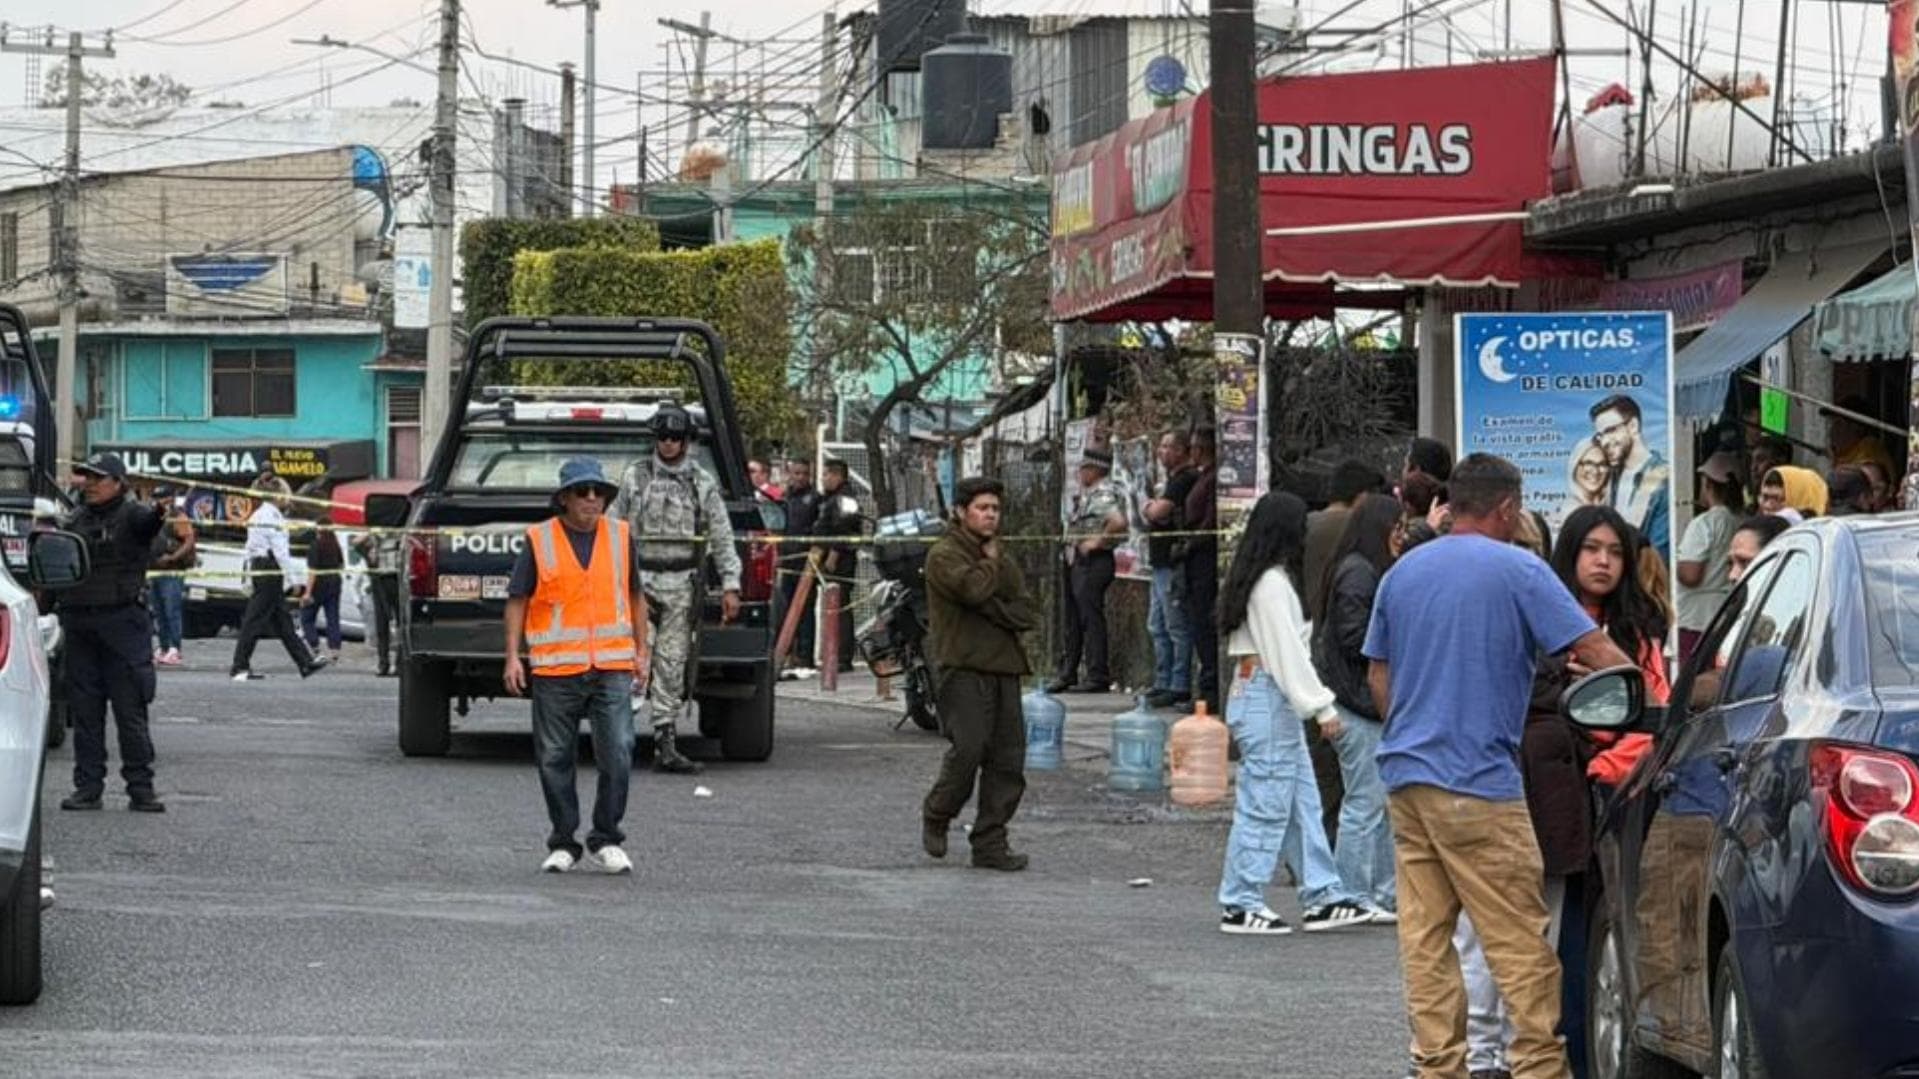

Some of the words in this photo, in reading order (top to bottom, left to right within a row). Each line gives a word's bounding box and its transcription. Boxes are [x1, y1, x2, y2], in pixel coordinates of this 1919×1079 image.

[1519, 327, 1634, 351] OPTICAS
[1521, 375, 1547, 391] DE
[1555, 373, 1643, 390] CALIDAD
[451, 533, 526, 554] POLIC
